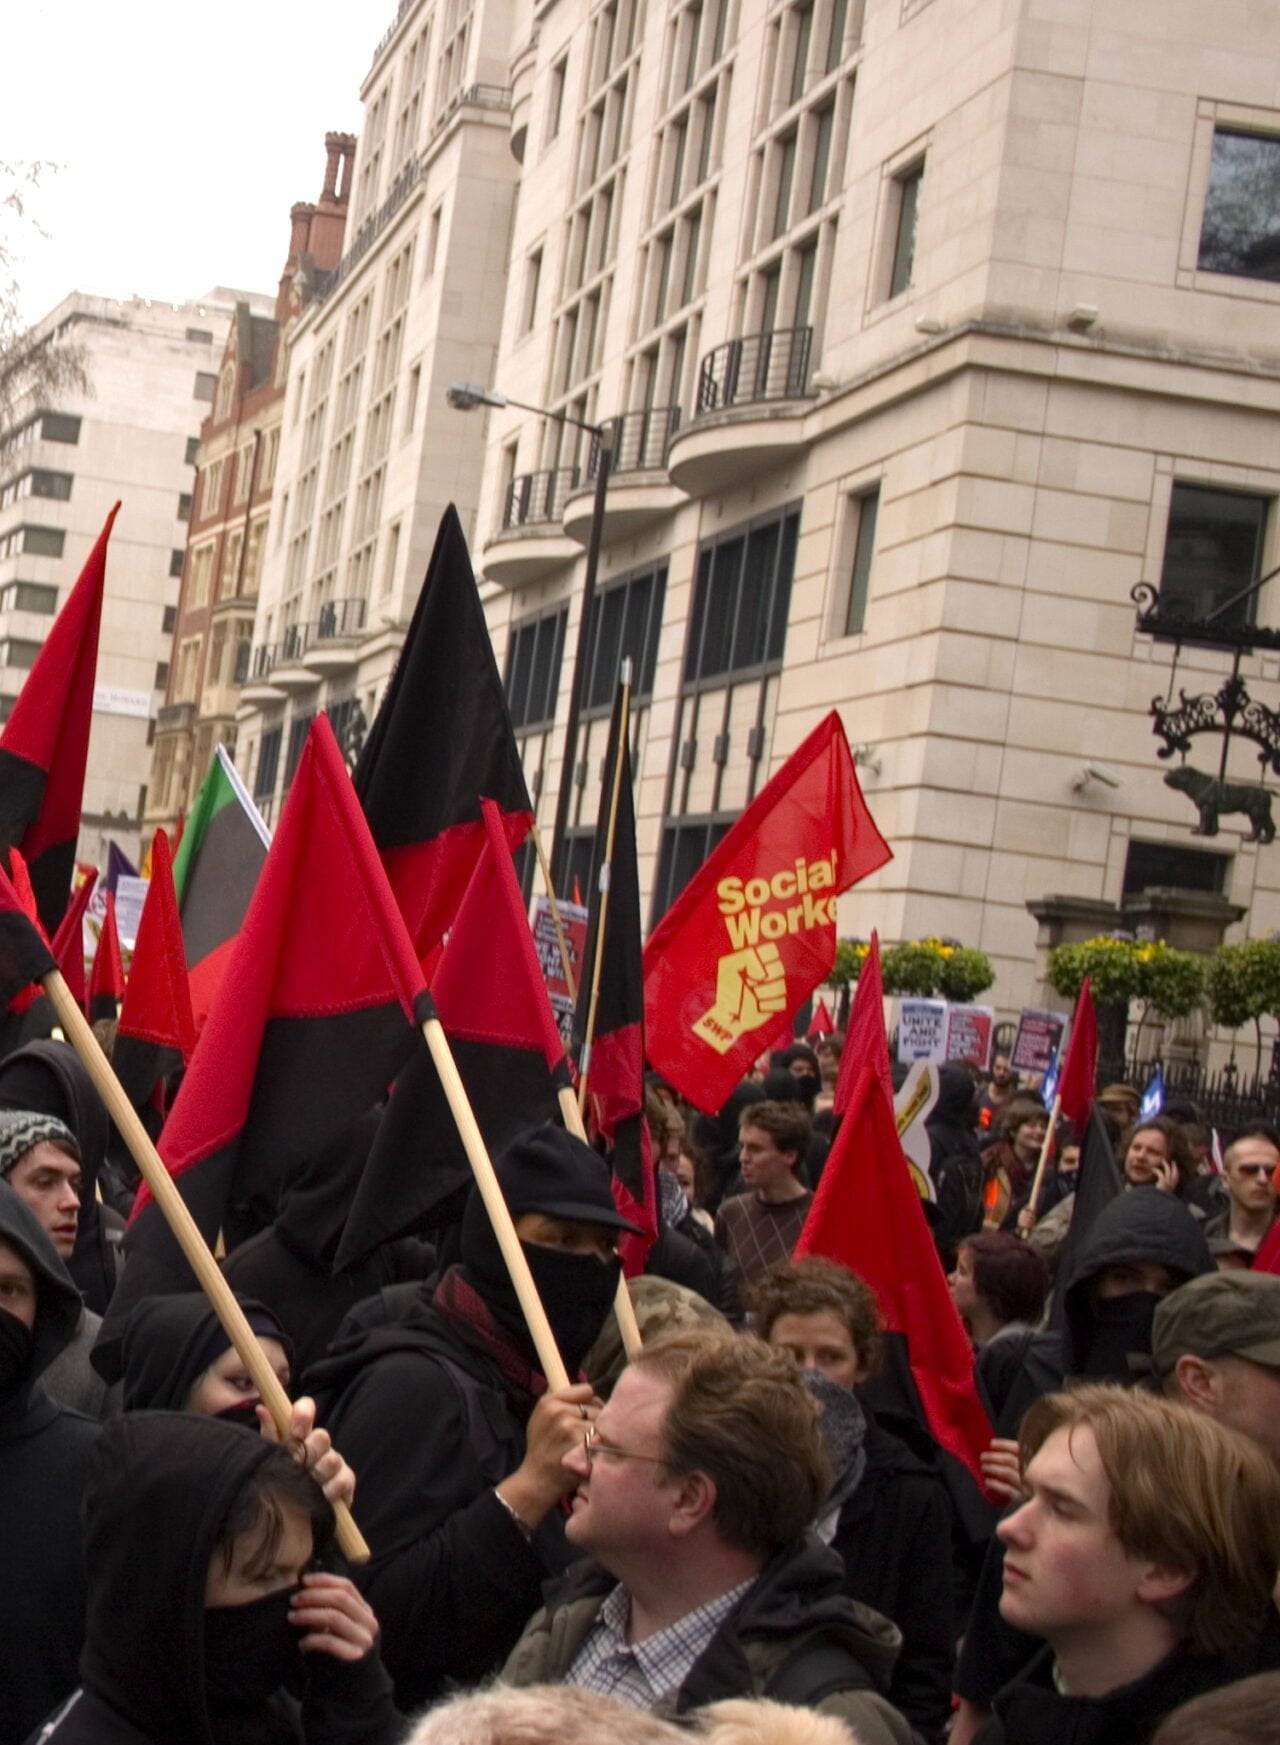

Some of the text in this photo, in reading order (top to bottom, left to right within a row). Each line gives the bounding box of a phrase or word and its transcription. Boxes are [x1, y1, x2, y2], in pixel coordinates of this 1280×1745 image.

[903, 1015, 941, 1028] UNITE
[702, 1016, 733, 1040] SWP
[910, 1026, 937, 1037] AND
[903, 1037, 940, 1048] FIGHT
